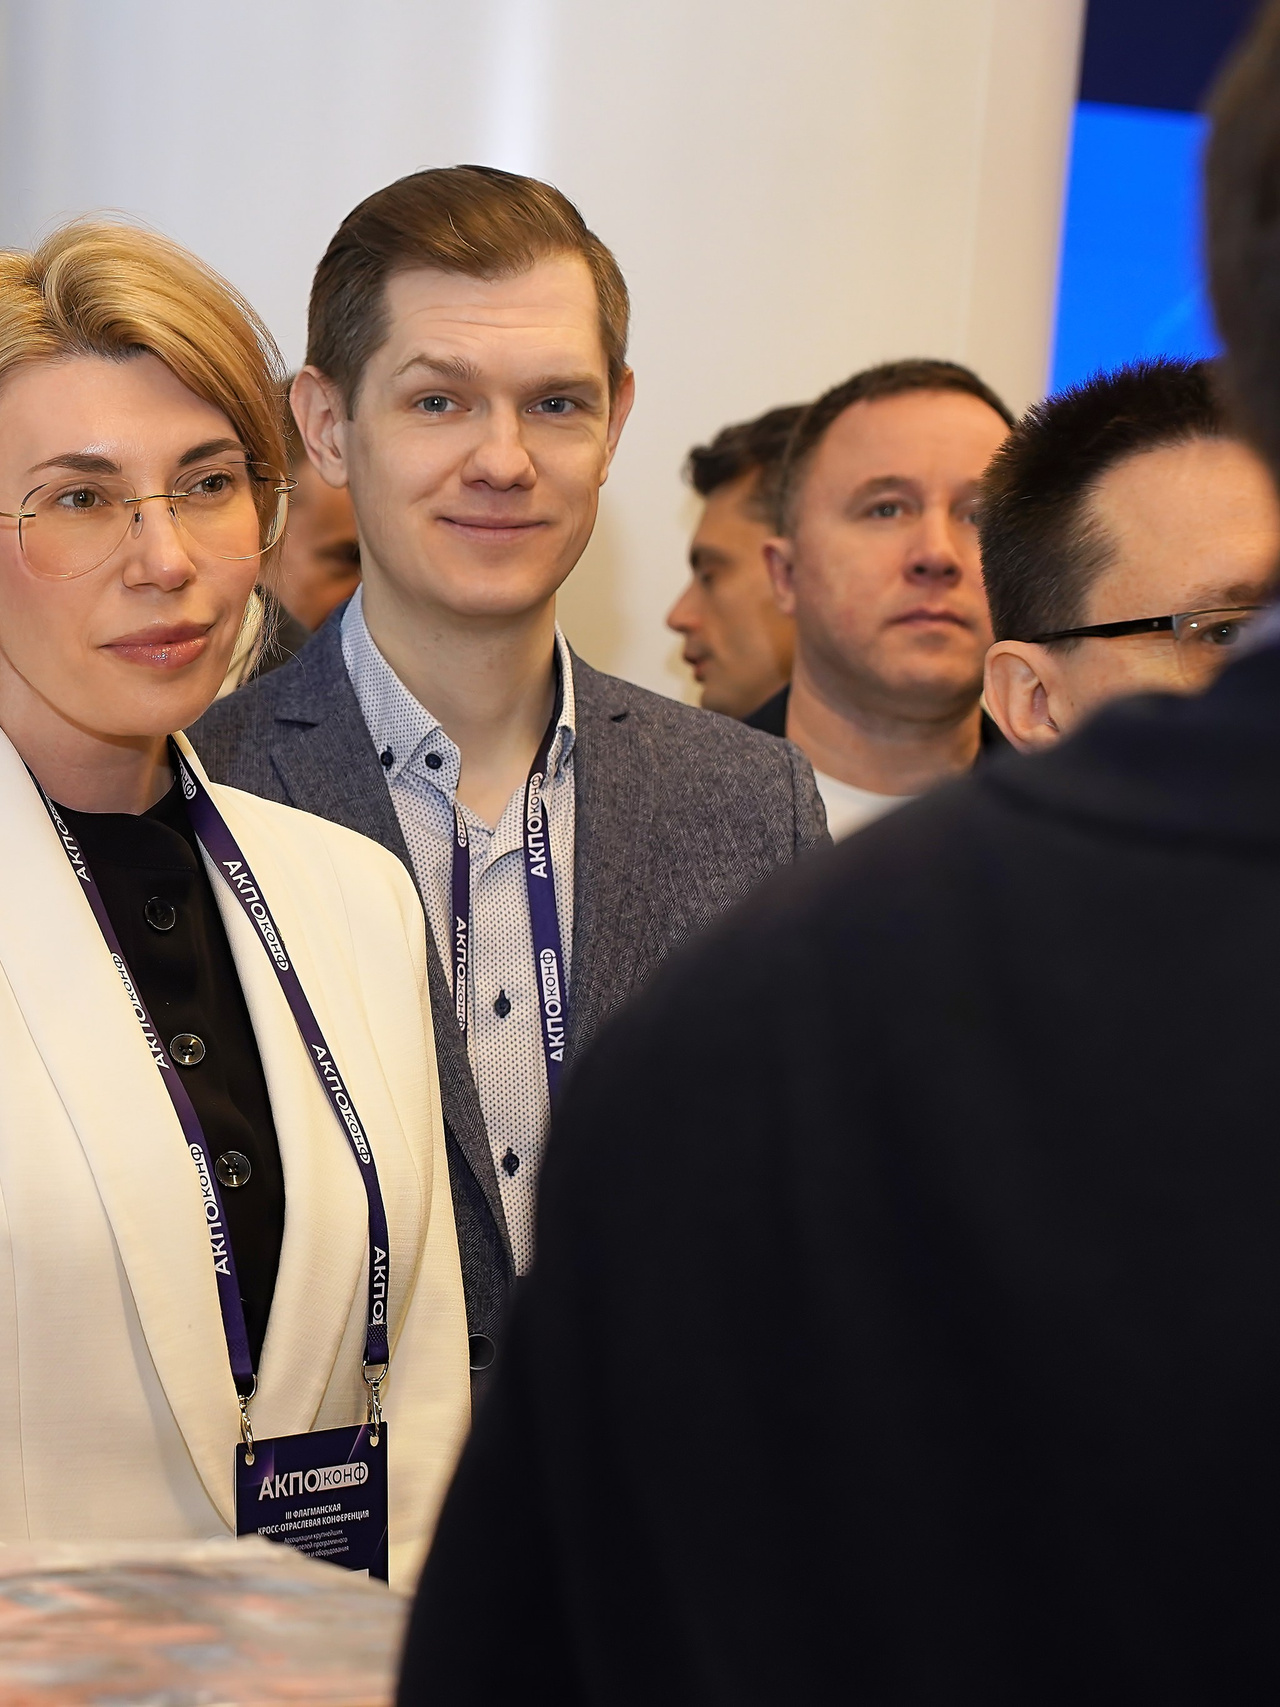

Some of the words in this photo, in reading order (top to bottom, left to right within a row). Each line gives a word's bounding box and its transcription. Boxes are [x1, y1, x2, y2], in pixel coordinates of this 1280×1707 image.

[373, 1246, 387, 1324] АКПО
[258, 1518, 321, 1536] КРОСС-ОТРАСЛЕВАЯ
[322, 1509, 370, 1525] КОНФЕРЕНЦИЯ
[293, 1503, 341, 1519] ФЛАГМАНСКАЯ
